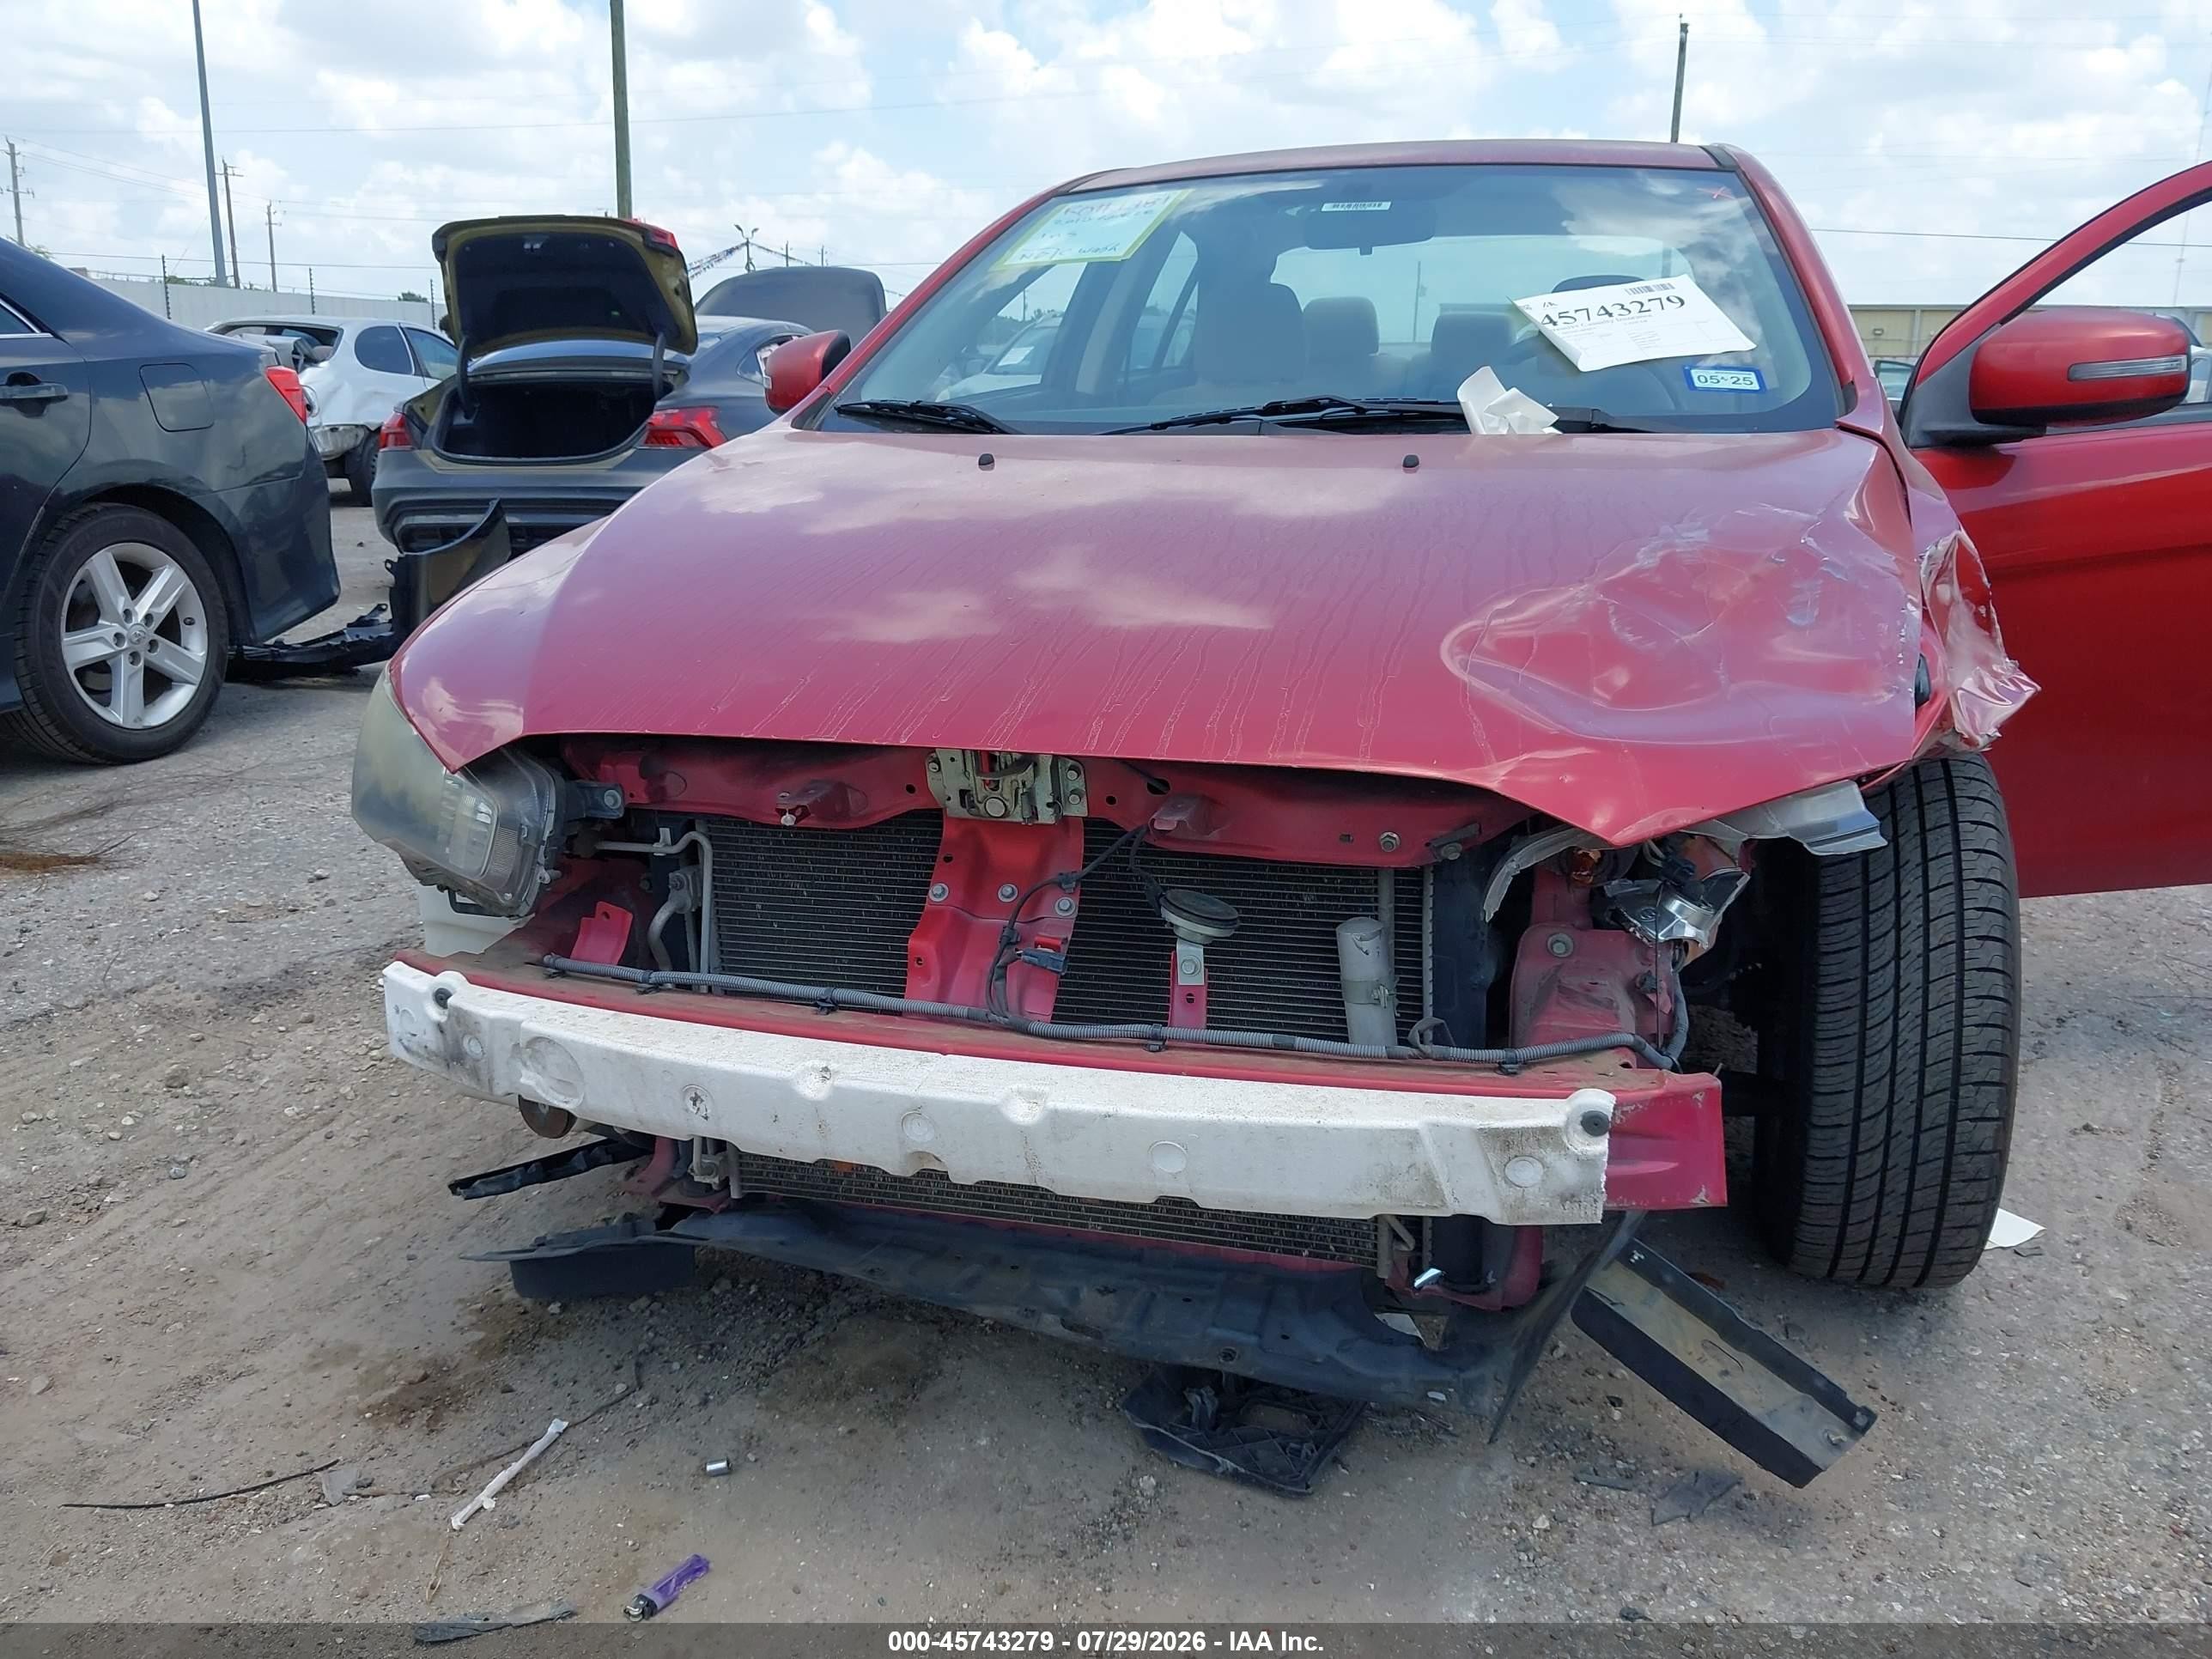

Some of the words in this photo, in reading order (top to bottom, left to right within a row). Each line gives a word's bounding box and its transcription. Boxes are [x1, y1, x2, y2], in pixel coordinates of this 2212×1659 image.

[1540, 295, 1687, 327] 45743279
[1696, 374, 1721, 385] 05
[1729, 375, 1754, 386] 25
